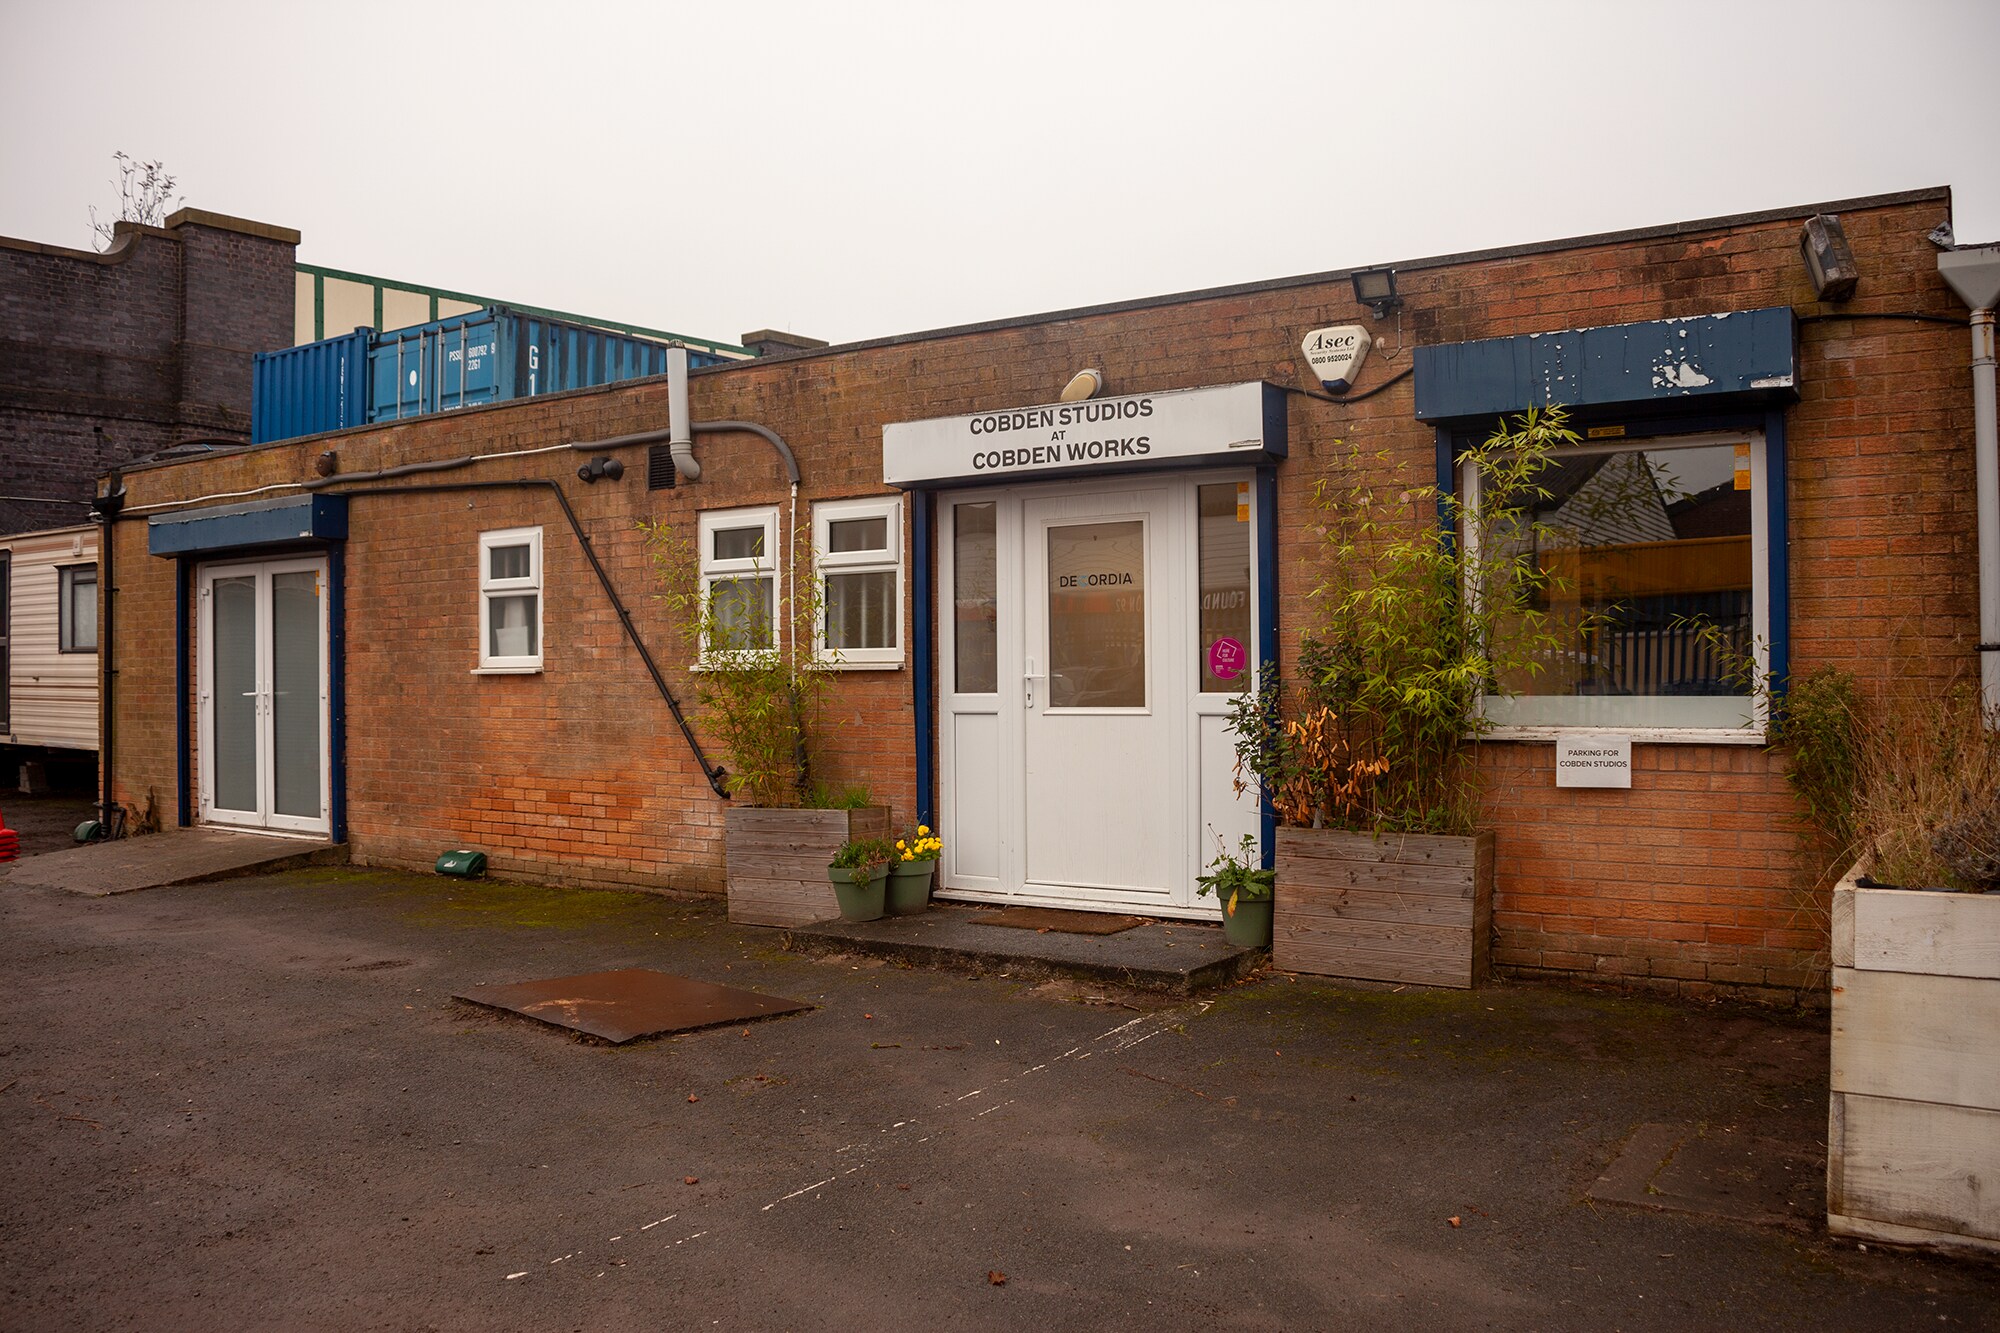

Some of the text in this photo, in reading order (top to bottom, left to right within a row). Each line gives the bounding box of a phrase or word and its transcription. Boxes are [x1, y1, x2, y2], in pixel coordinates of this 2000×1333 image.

[1309, 333, 1354, 350] Asec
[1327, 353, 1351, 362] 9520024
[970, 399, 1153, 435] COBDEN STUDIOS
[1051, 430, 1066, 442] AT
[973, 436, 1151, 469] COBDEN WORKS
[1060, 572, 1133, 588] DECORDIA
